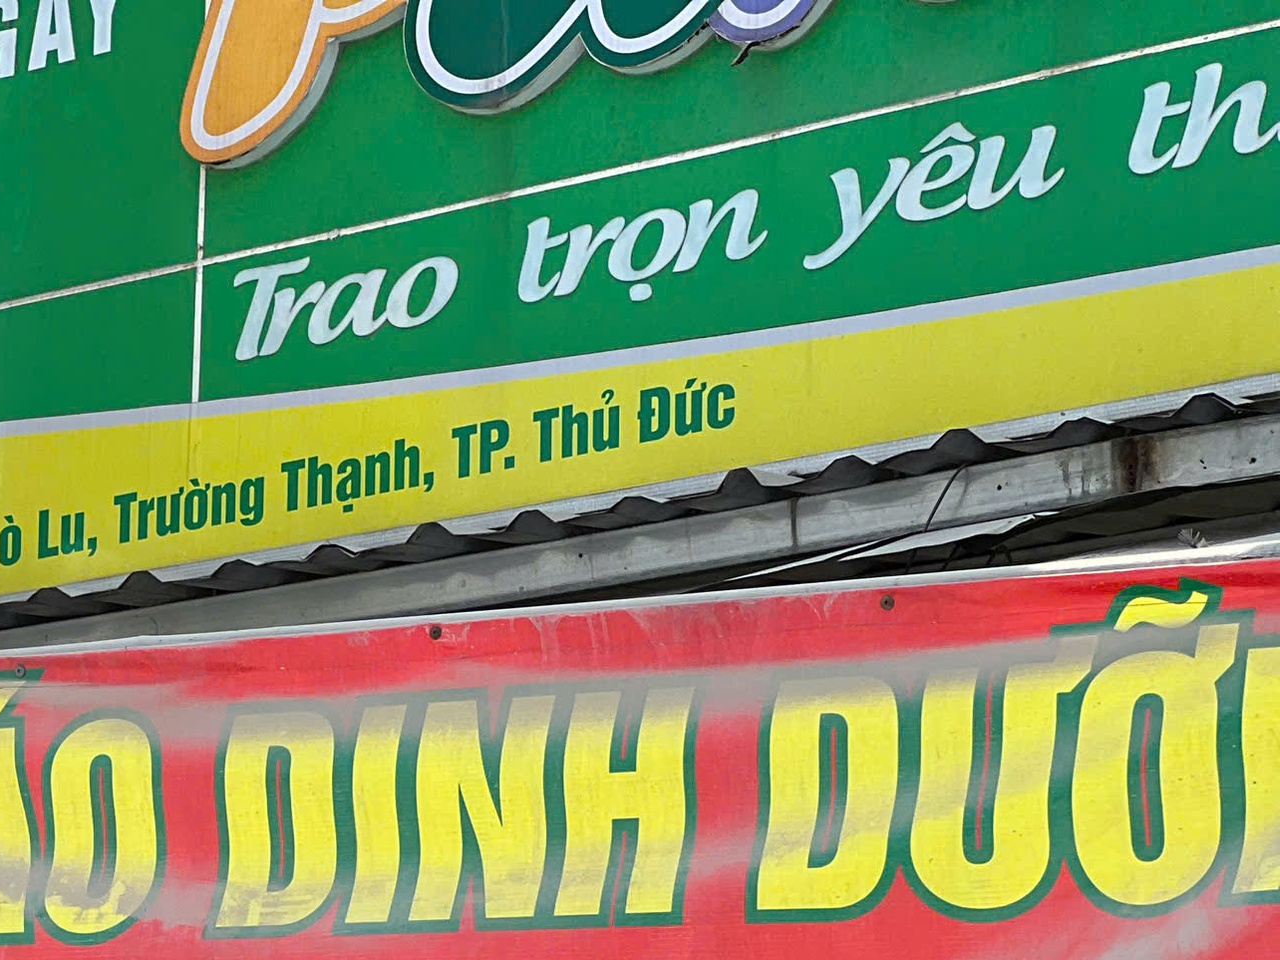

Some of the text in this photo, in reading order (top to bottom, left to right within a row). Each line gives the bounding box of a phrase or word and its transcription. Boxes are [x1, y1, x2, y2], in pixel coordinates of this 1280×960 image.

[232, 62, 1280, 362] Trao trọn yêu th
[37, 509, 98, 559] Lu,
[114, 477, 265, 545] Trường
[280, 438, 435, 514] Thạnh,
[451, 419, 516, 474] TP.
[532, 389, 620, 464] Thủ
[637, 377, 737, 444] Đức
[206, 675, 704, 940] DINH
